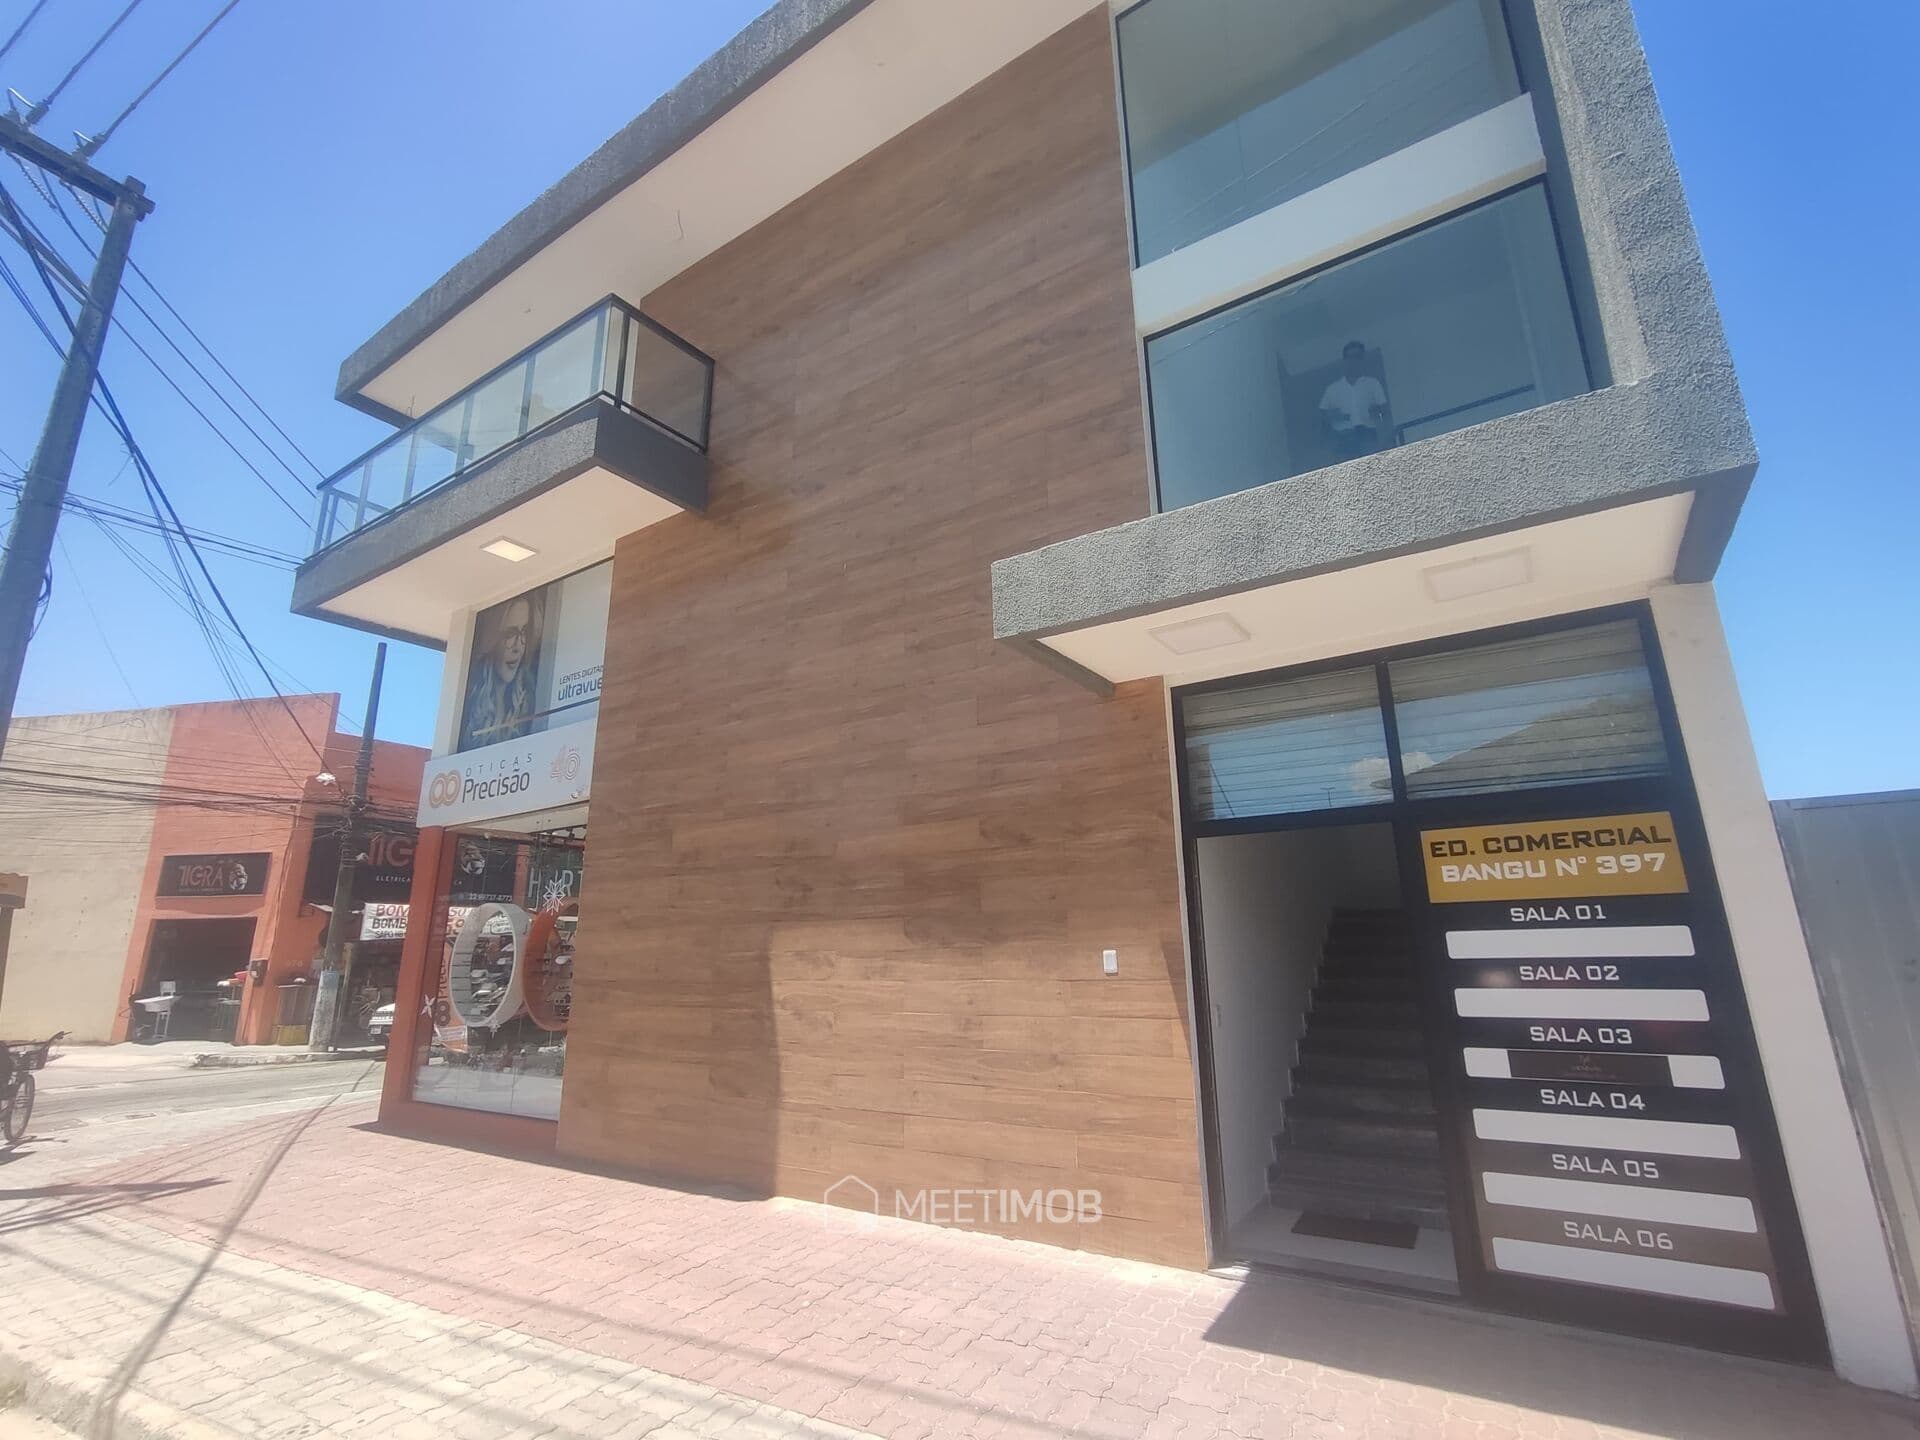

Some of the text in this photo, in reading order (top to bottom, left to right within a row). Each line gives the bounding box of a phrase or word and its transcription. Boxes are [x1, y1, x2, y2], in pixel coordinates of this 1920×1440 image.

[560, 671, 581, 685] LENTES
[462, 767, 531, 803] Precisão
[1430, 826, 1672, 858] ED. COMERCIAL
[1441, 859, 1547, 883] BANGU
[1597, 852, 1667, 875] 397
[1510, 905, 1607, 923] SALA 01
[1520, 965, 1620, 981] SALA 02
[1530, 1026, 1633, 1045] SALA 03
[1540, 1089, 1646, 1111] SALA 04
[1552, 1153, 1660, 1179] SALA 05
[1564, 1221, 1674, 1250] SALA 06
